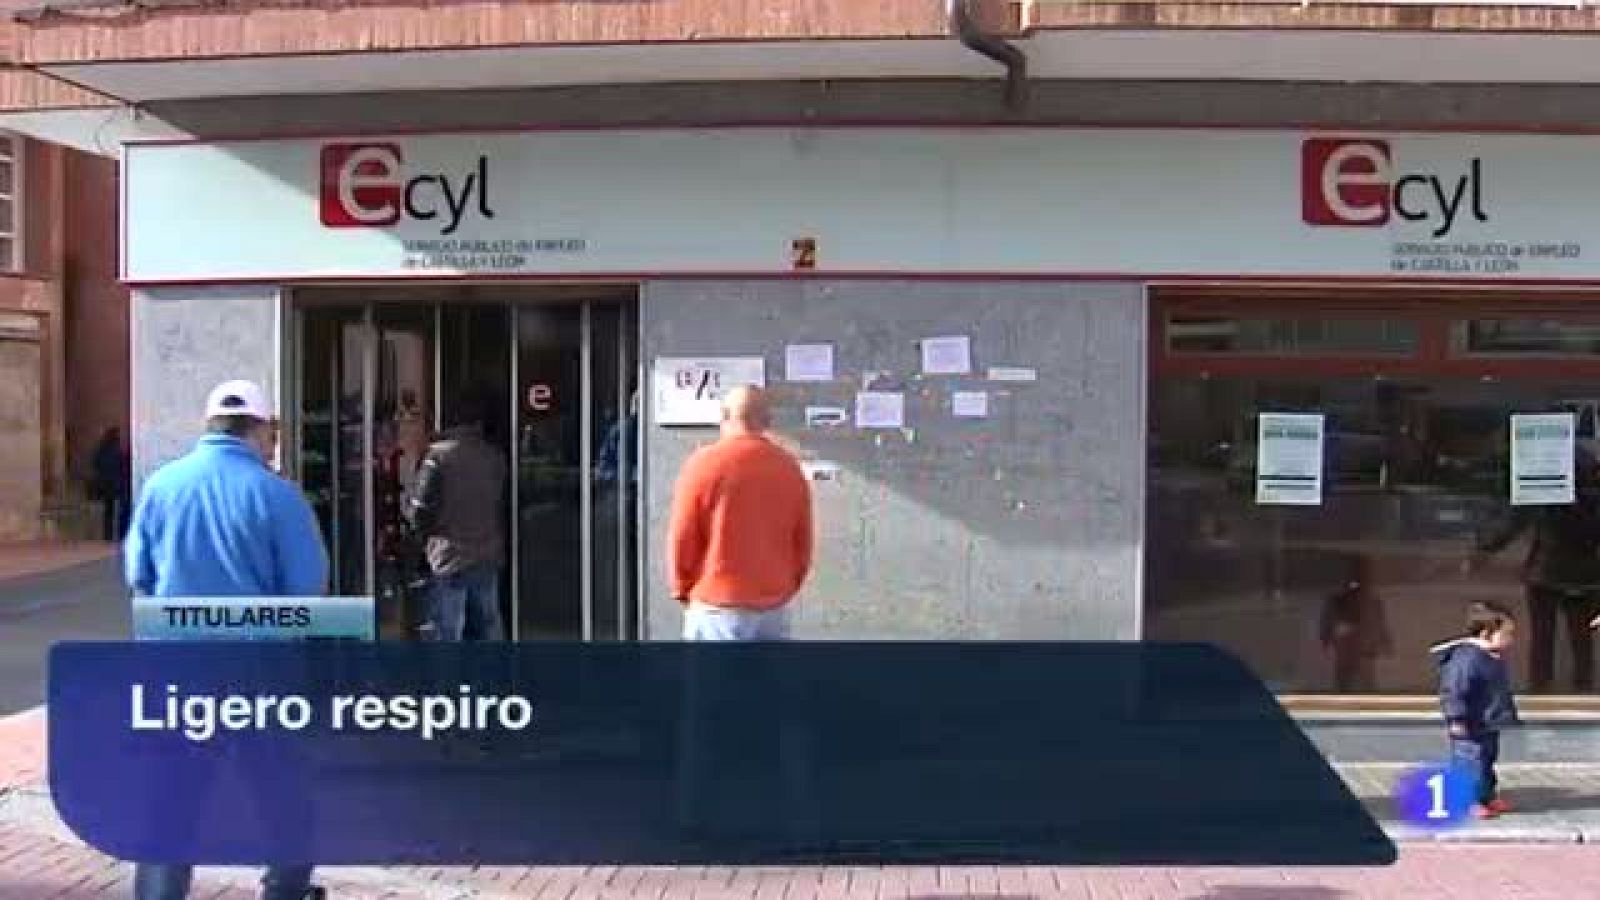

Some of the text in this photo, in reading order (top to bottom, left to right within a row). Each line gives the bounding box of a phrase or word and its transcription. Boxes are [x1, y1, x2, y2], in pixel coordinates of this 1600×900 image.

[339, 147, 494, 235] ecyl
[1323, 144, 1488, 237] ecyl
[528, 384, 551, 411] e
